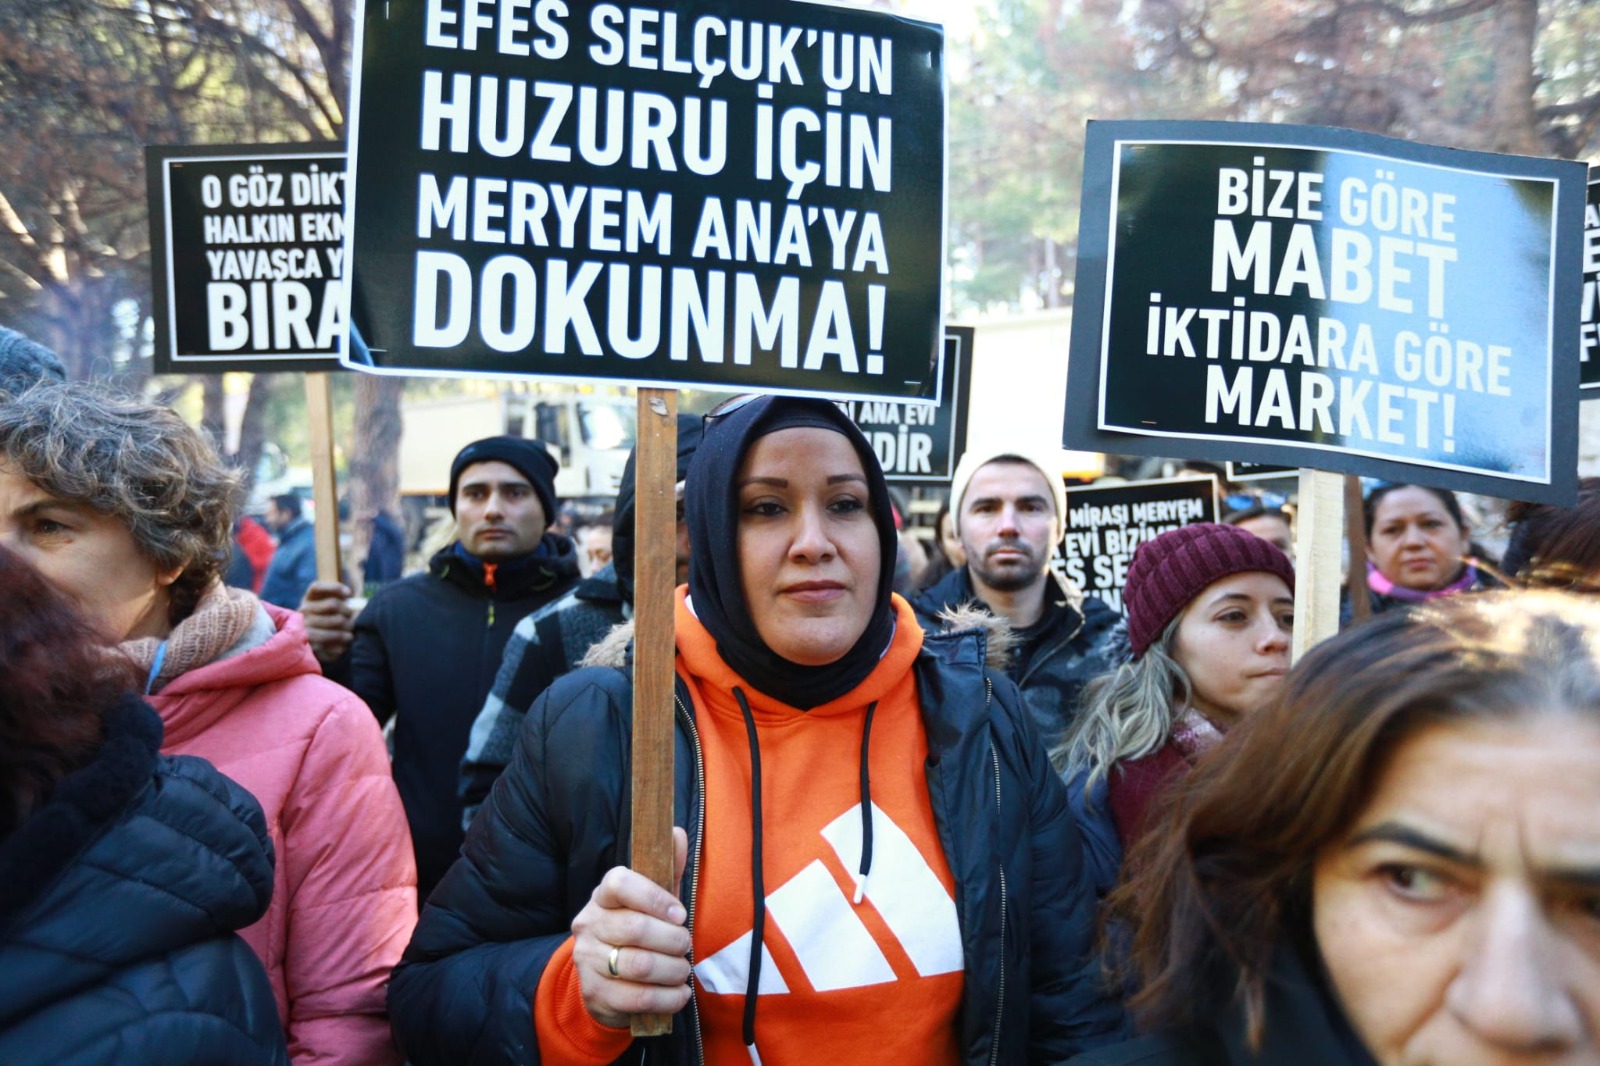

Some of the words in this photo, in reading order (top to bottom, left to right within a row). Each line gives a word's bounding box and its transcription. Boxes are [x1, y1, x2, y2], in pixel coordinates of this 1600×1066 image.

[425, 0, 569, 59] EFES
[589, 3, 893, 95] SELÇUK'UN
[421, 71, 728, 175] HUZURU
[755, 83, 892, 200] İÇİN
[202, 175, 222, 208] O
[229, 165, 285, 208] GÖZ
[291, 163, 347, 206] DİK
[203, 213, 295, 244] HALKIN
[417, 172, 672, 256] MERYEM
[692, 197, 889, 275] ANA'YA
[1217, 156, 1324, 221] BİZE
[1340, 169, 1456, 242] GÖRE
[413, 250, 886, 375] DOKUNMA!
[1211, 219, 1458, 319] MABET
[1146, 293, 1379, 376] İKTİDARA
[1394, 322, 1512, 397] GÖRE
[864, 424, 932, 473] DİR
[1204, 365, 1456, 453] MARKET!
[1065, 526, 1100, 558] EVİ
[1069, 503, 1129, 528] MİRASI
[1132, 498, 1204, 523] MERYEM
